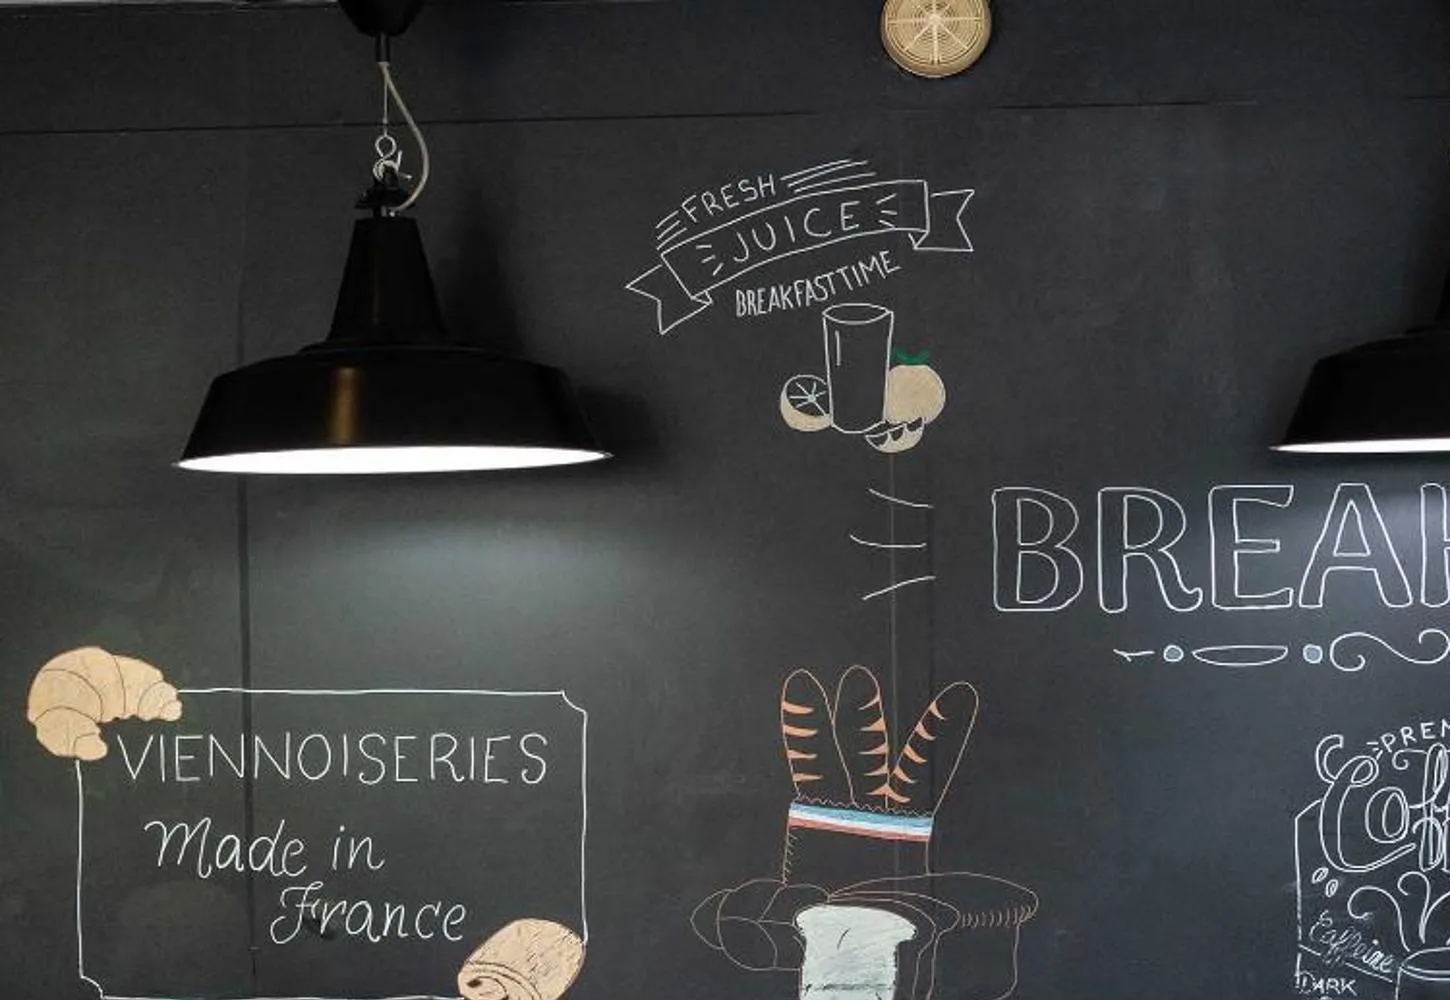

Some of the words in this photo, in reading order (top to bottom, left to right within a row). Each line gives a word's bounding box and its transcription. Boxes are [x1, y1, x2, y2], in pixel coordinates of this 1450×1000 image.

[682, 174, 775, 223] FRESH
[733, 201, 860, 262] JUICE
[117, 732, 548, 785] VIENNOISERIES
[144, 817, 308, 879] Made
[331, 825, 386, 872] in
[269, 881, 466, 945] France
[1299, 970, 1357, 996] DARK
